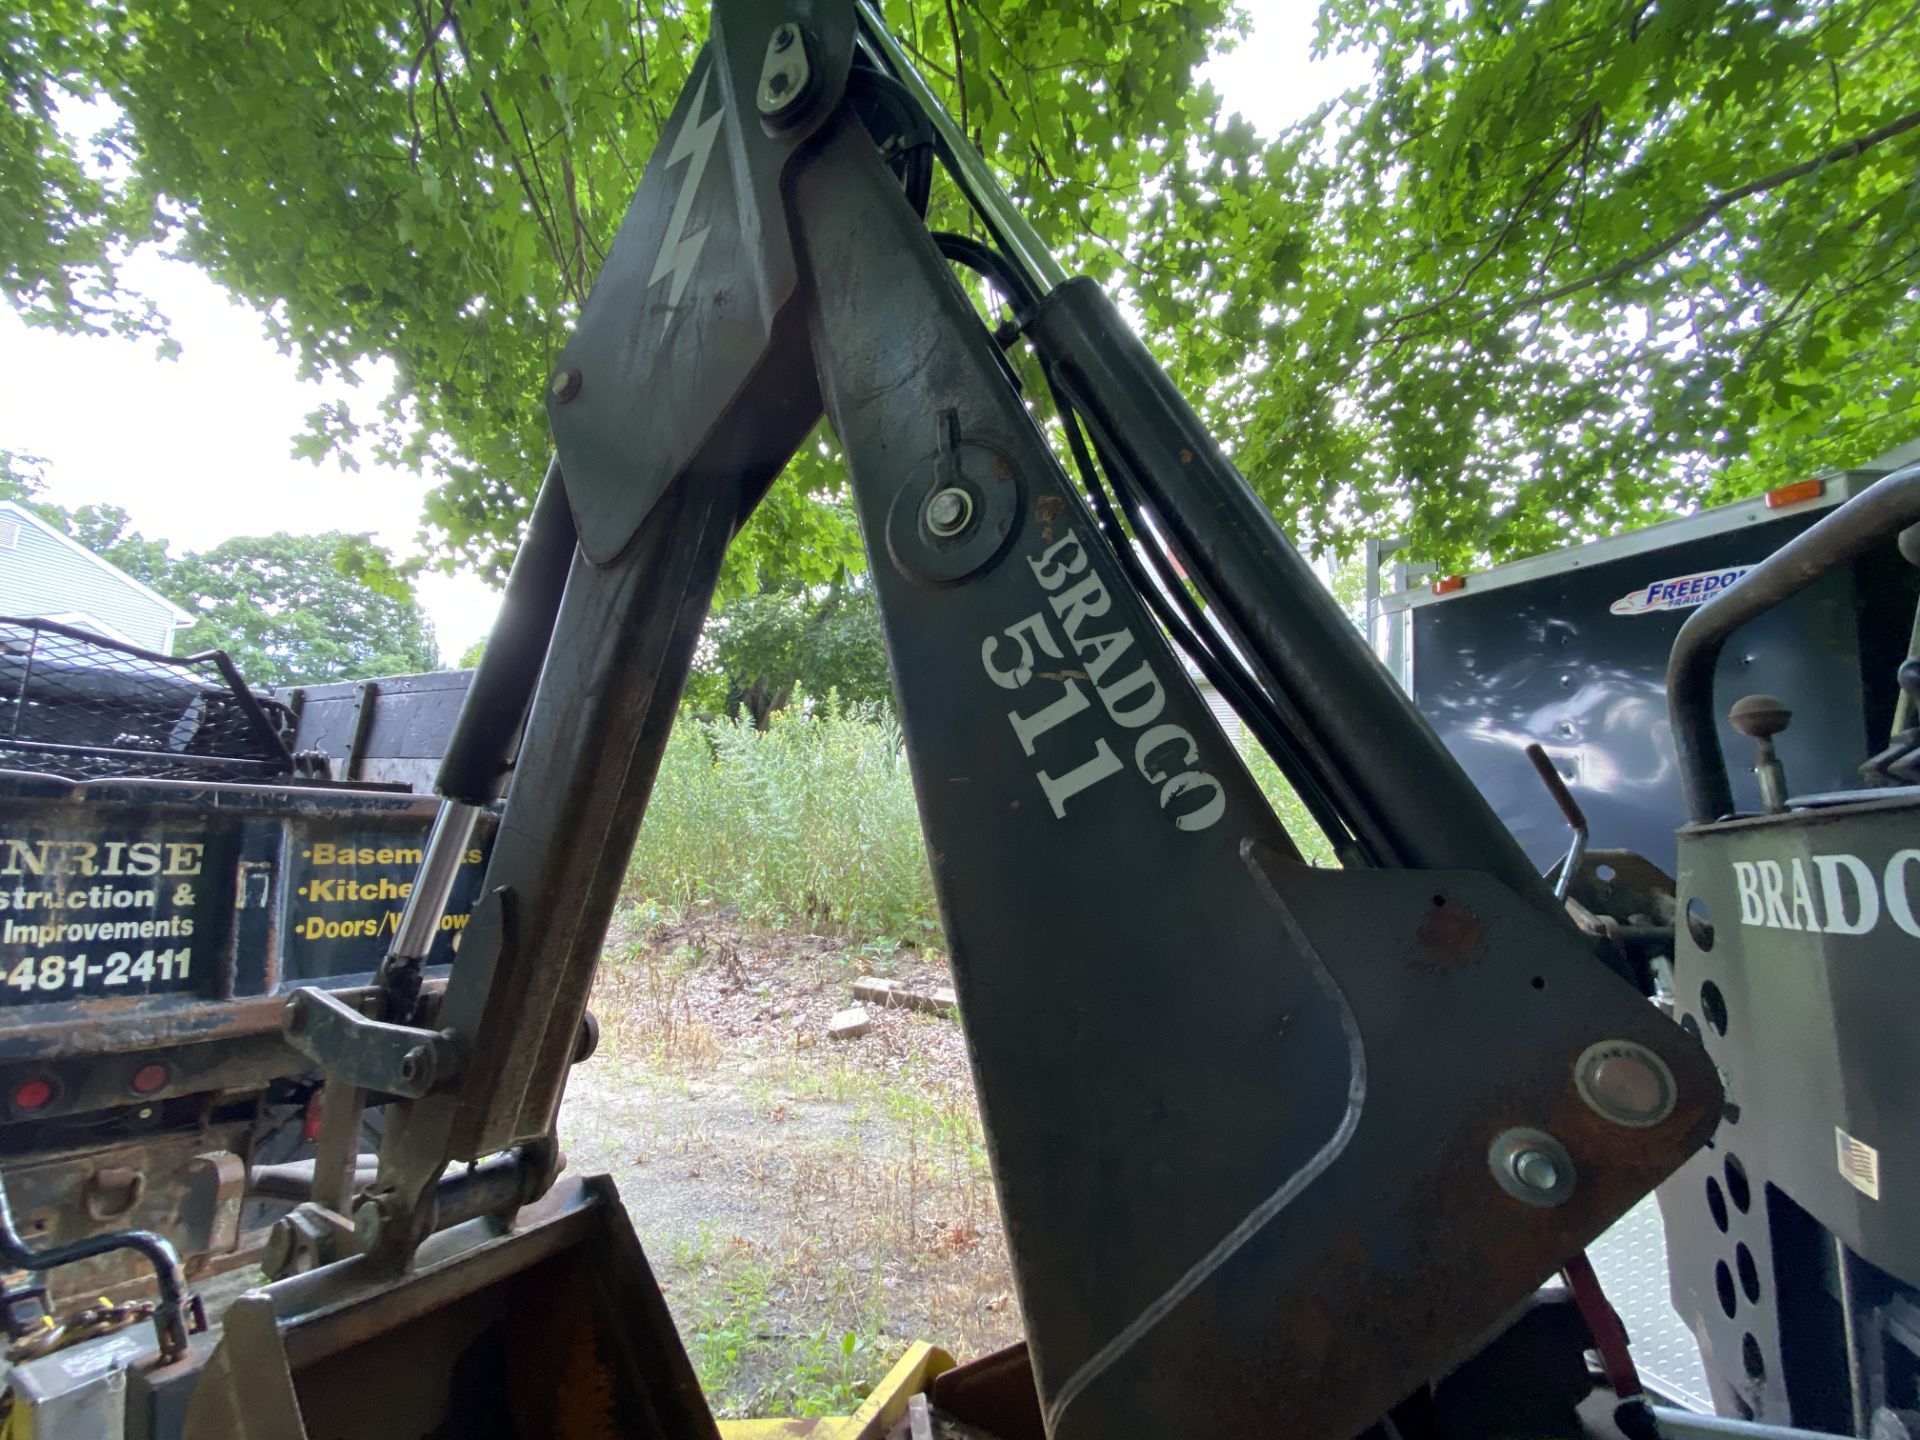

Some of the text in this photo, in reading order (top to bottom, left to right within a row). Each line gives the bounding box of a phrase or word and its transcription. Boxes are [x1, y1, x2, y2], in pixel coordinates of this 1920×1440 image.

[1647, 570, 1746, 605] FREEDO
[1026, 528, 1226, 832] BRADCO
[981, 612, 1125, 819] 511
[0, 839, 204, 877] NRISE
[313, 844, 482, 865] Basems
[172, 883, 196, 906] &
[310, 879, 413, 902] Kitche
[4, 915, 194, 948] Improvements
